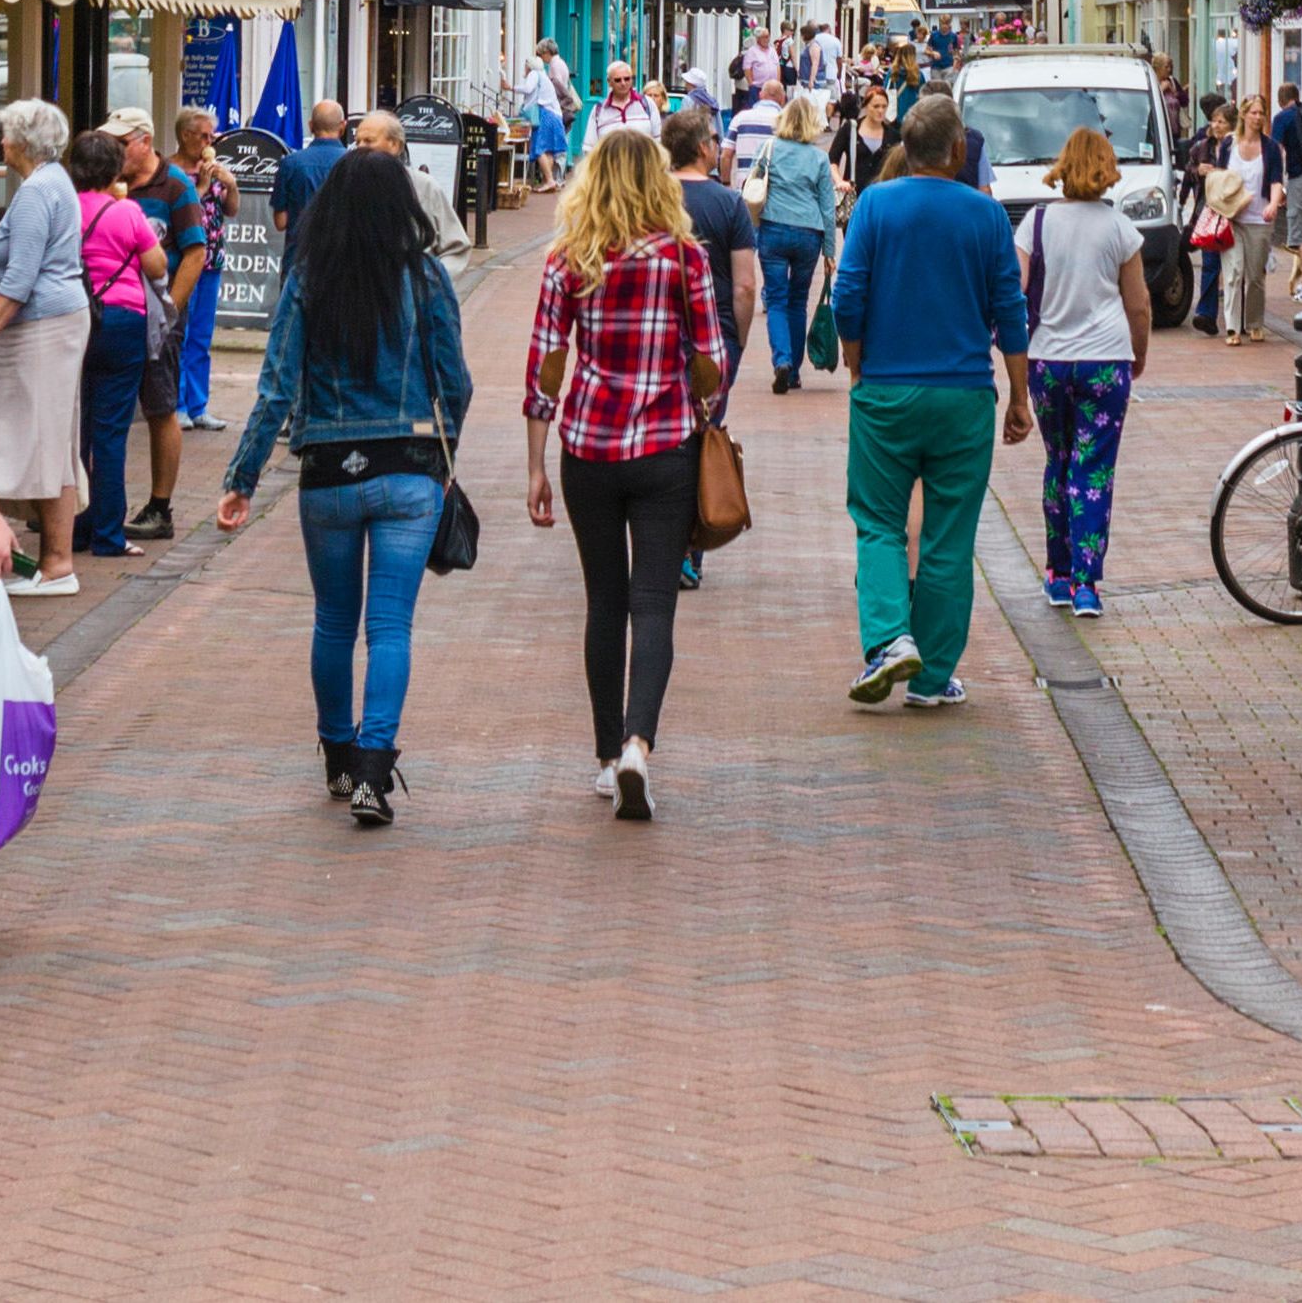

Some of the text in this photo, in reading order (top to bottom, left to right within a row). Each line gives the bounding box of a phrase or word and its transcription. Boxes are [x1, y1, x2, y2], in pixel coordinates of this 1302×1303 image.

[418, 106, 434, 114] THE
[237, 145, 258, 155] THE
[227, 224, 268, 244] EER
[224, 254, 282, 274] RDEN
